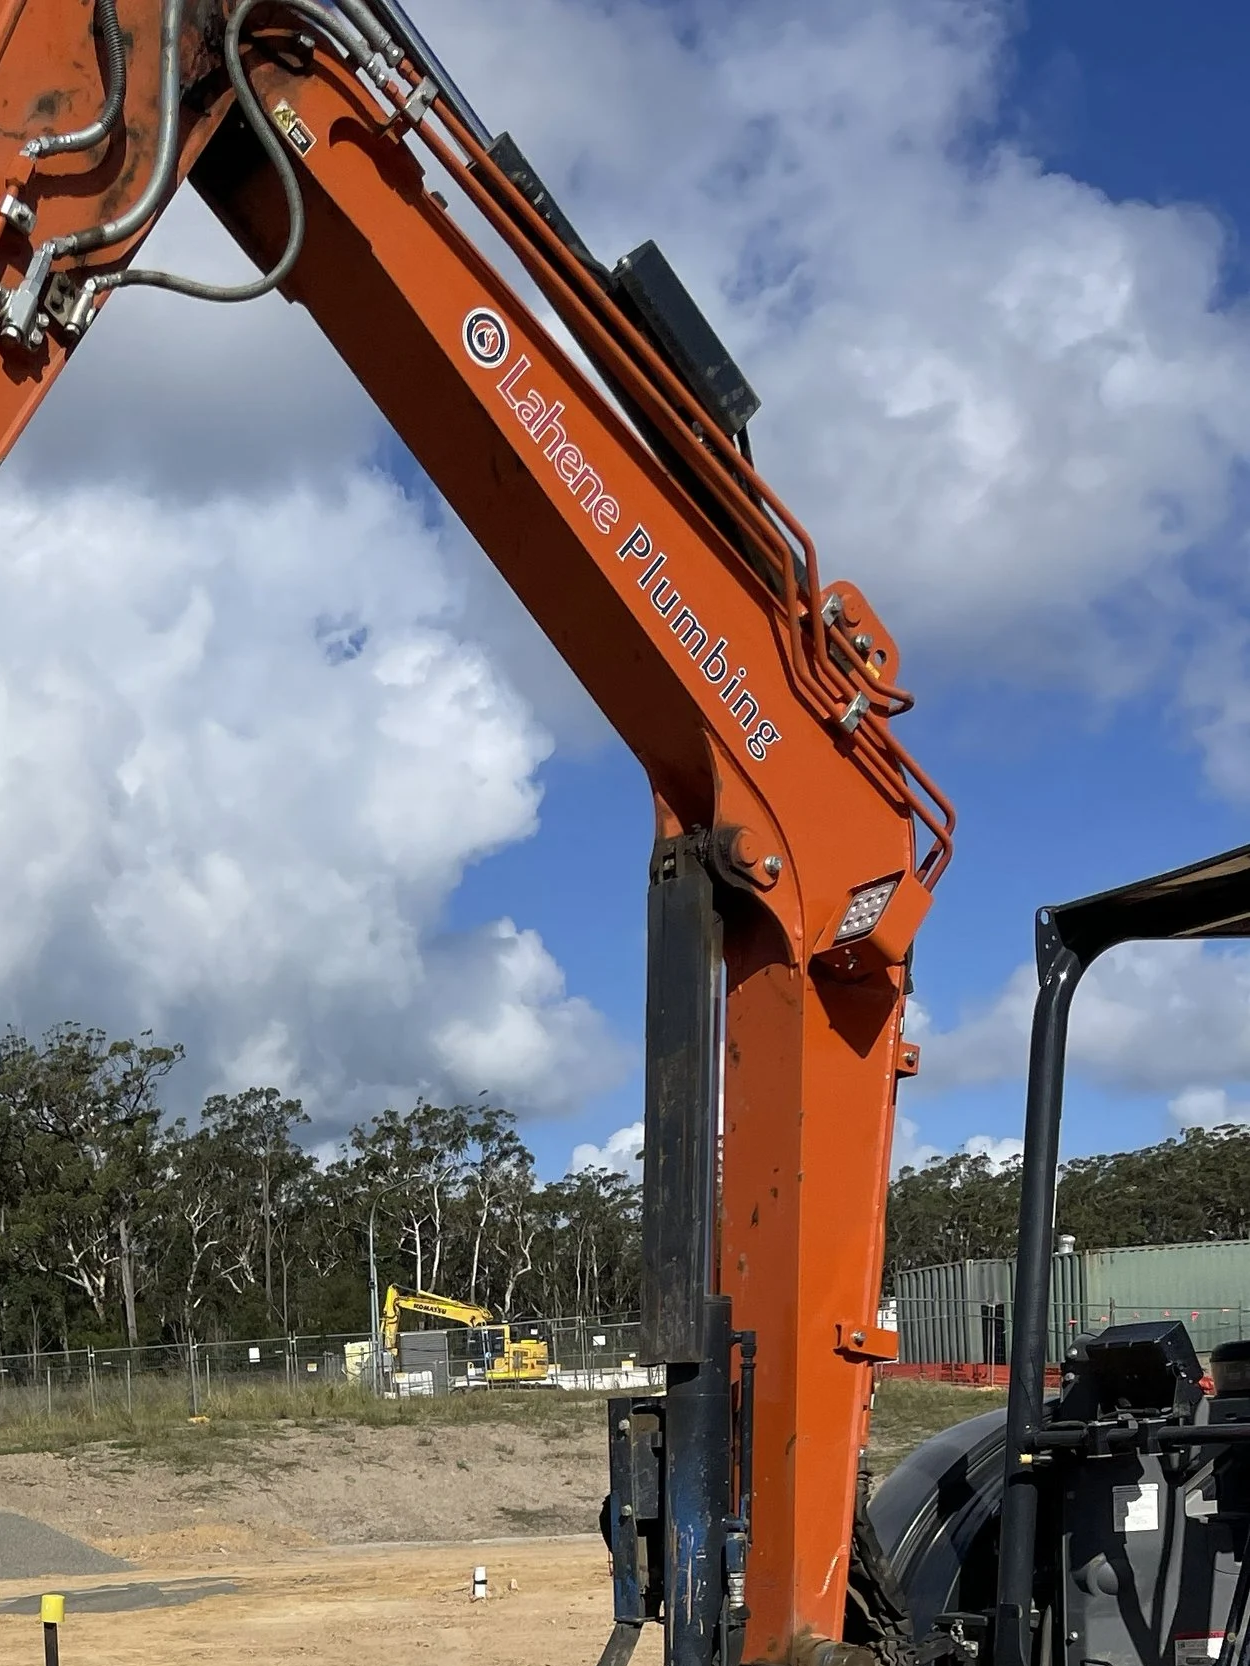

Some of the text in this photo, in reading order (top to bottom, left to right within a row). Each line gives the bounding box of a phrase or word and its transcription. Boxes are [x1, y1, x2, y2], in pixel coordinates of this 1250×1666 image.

[496, 353, 782, 761] Lahene Plumbing
[413, 1303, 447, 1315] KOMATSU
